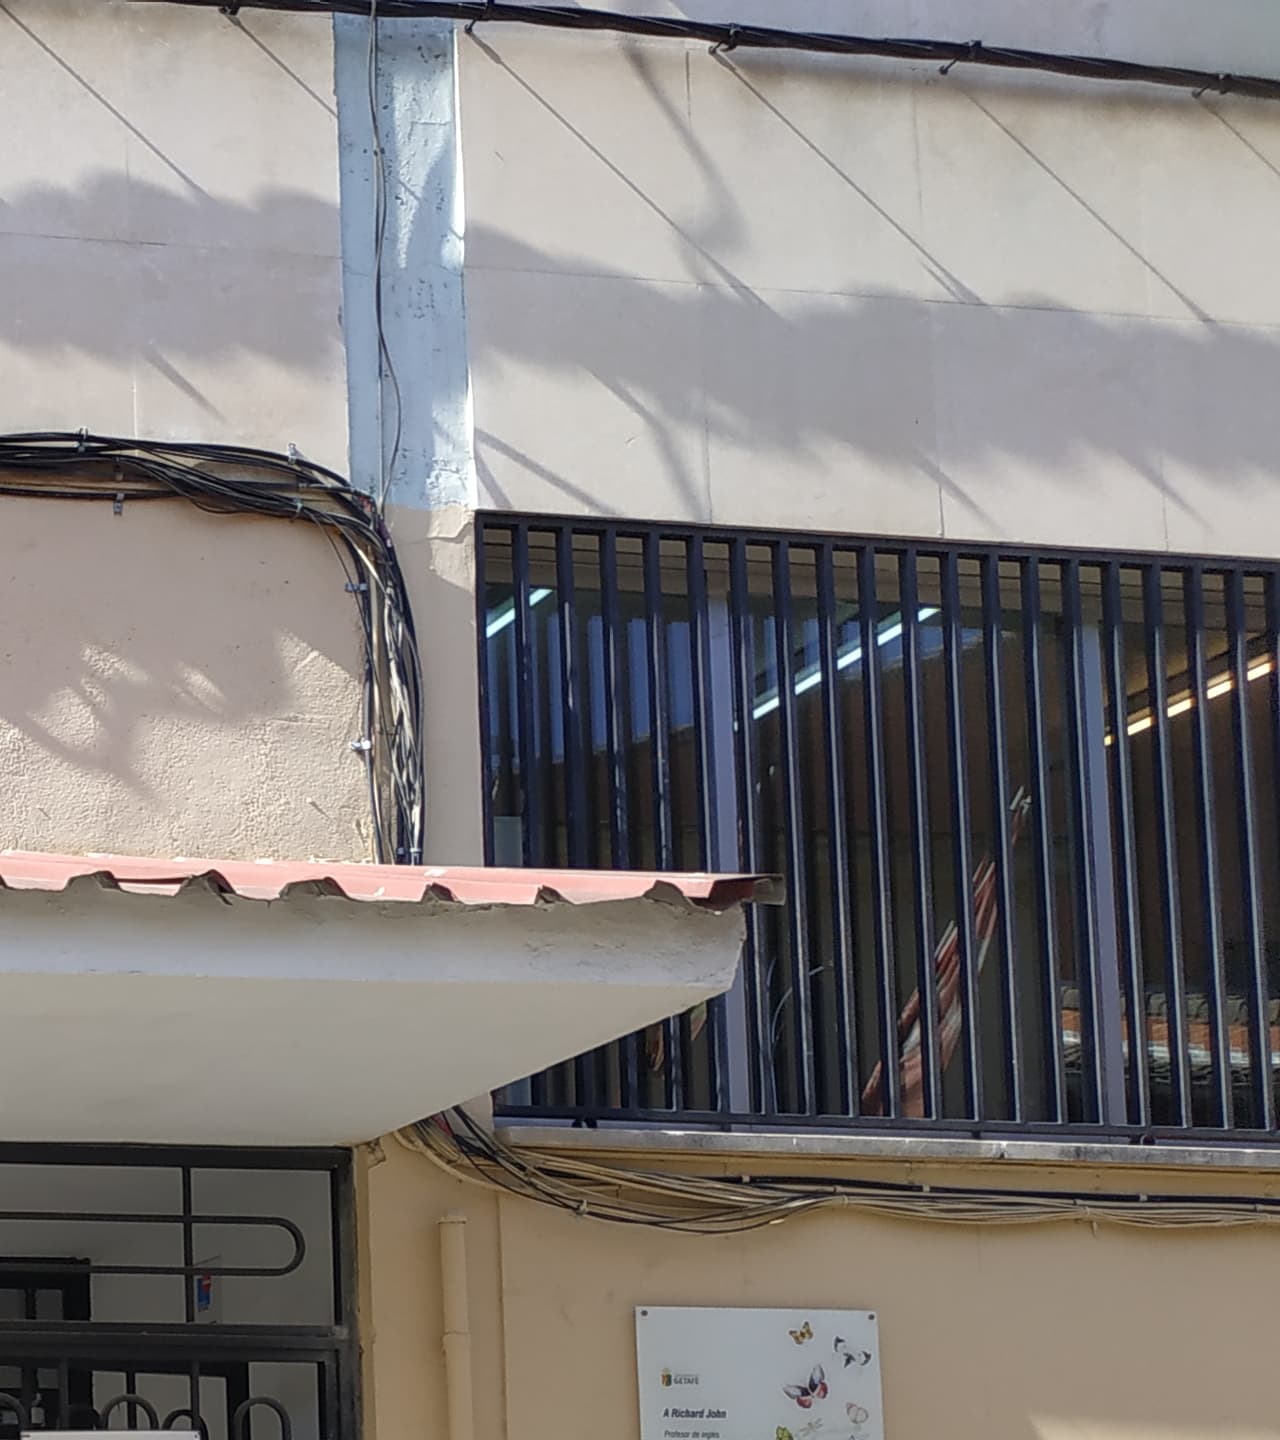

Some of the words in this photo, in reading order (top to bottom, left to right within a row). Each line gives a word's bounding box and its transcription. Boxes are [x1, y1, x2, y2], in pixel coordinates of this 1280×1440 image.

[664, 1409, 669, 1417] A
[672, 1409, 704, 1418] Richard
[706, 1410, 726, 1418] John
